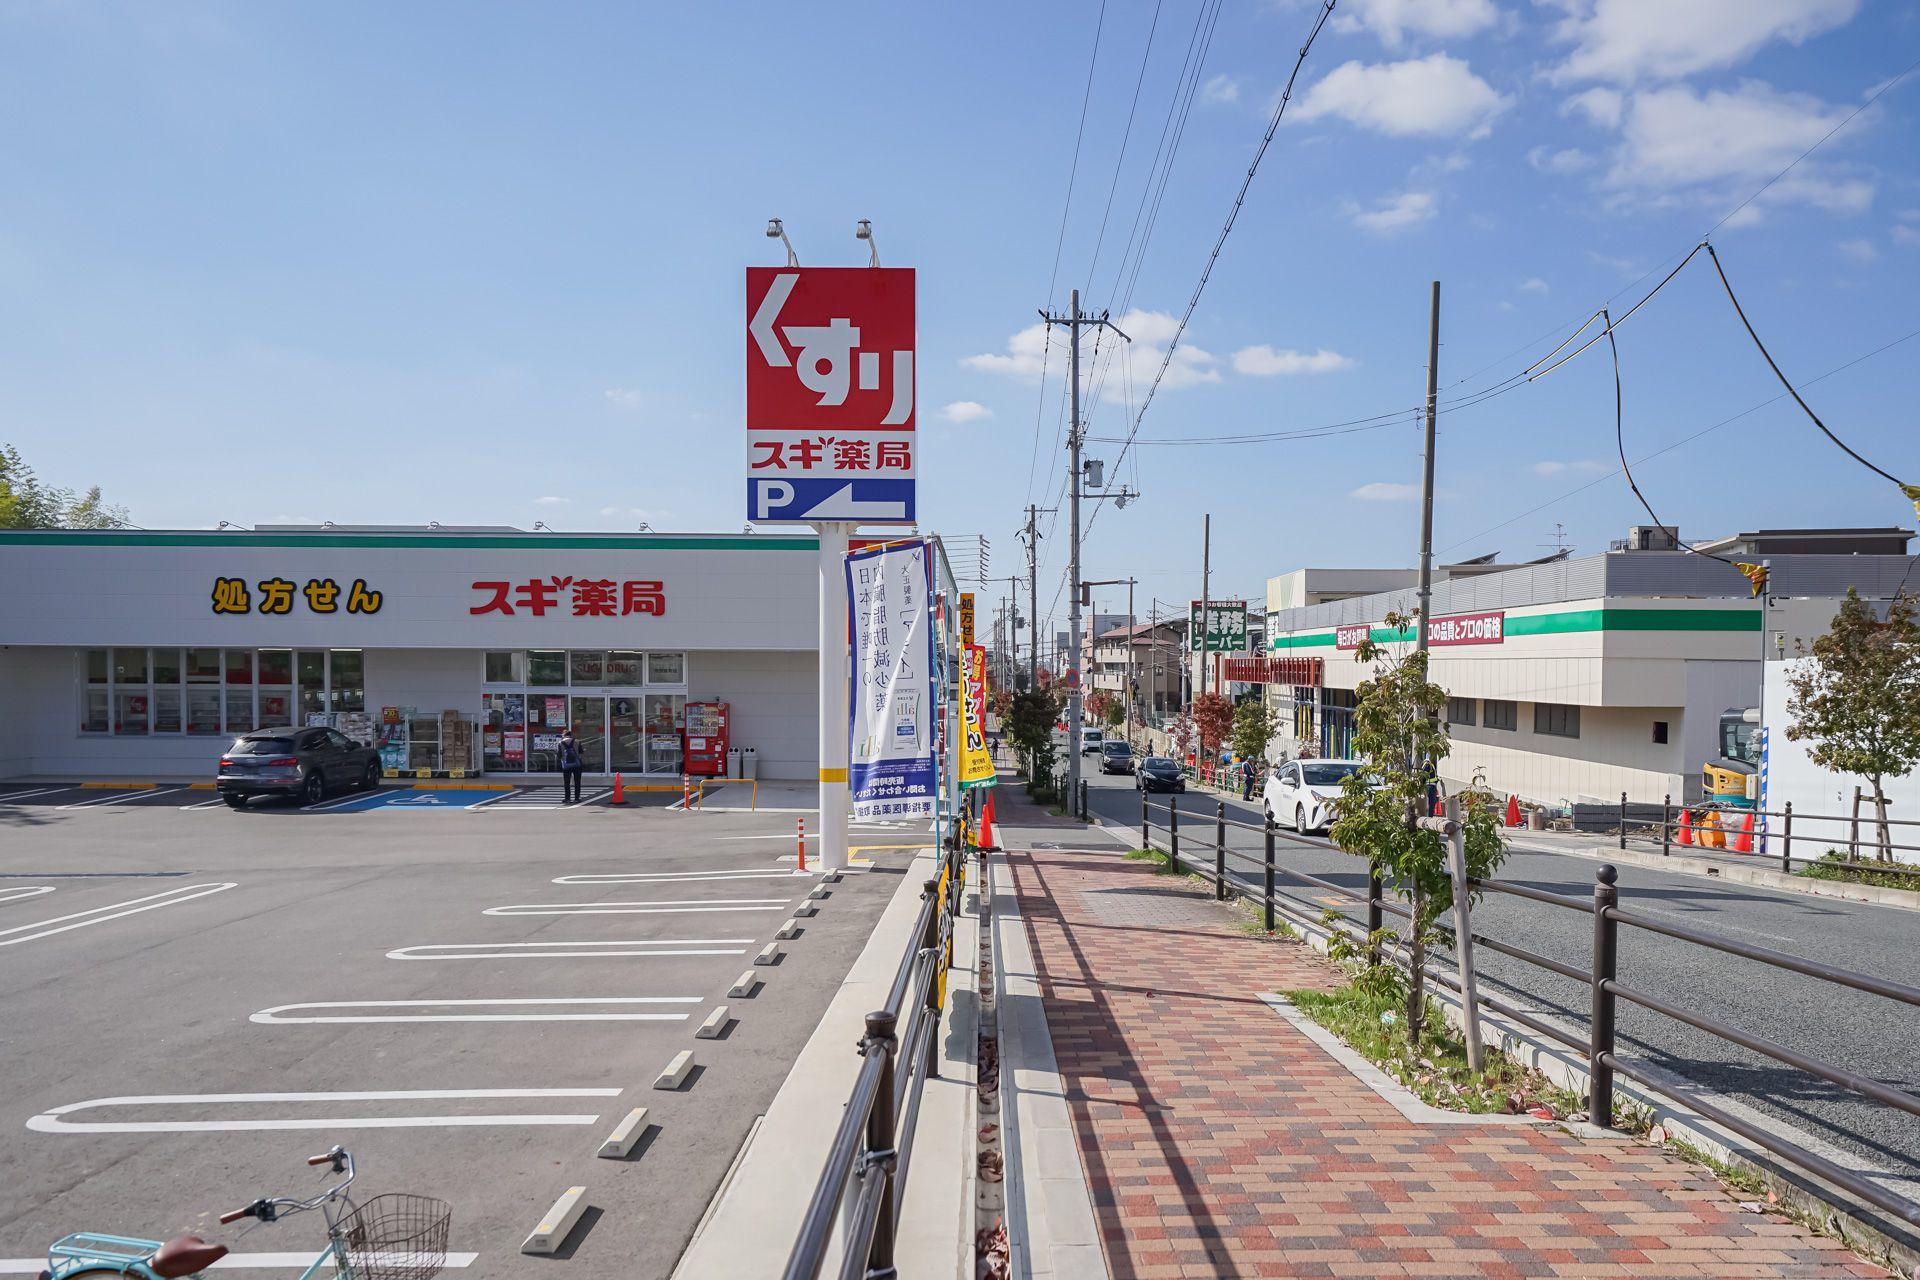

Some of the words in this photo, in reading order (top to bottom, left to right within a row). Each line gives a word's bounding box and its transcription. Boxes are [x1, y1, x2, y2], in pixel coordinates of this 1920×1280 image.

[749, 274, 914, 425] くすり
[751, 436, 911, 471] スギ薬局
[757, 480, 795, 519] P
[212, 576, 383, 615] 処方せん
[470, 576, 666, 617] スギ薬局
[1194, 610, 1244, 635] 業務
[1428, 617, 1501, 641] ロの品質とプロの価格
[1194, 635, 1244, 649] スーパー
